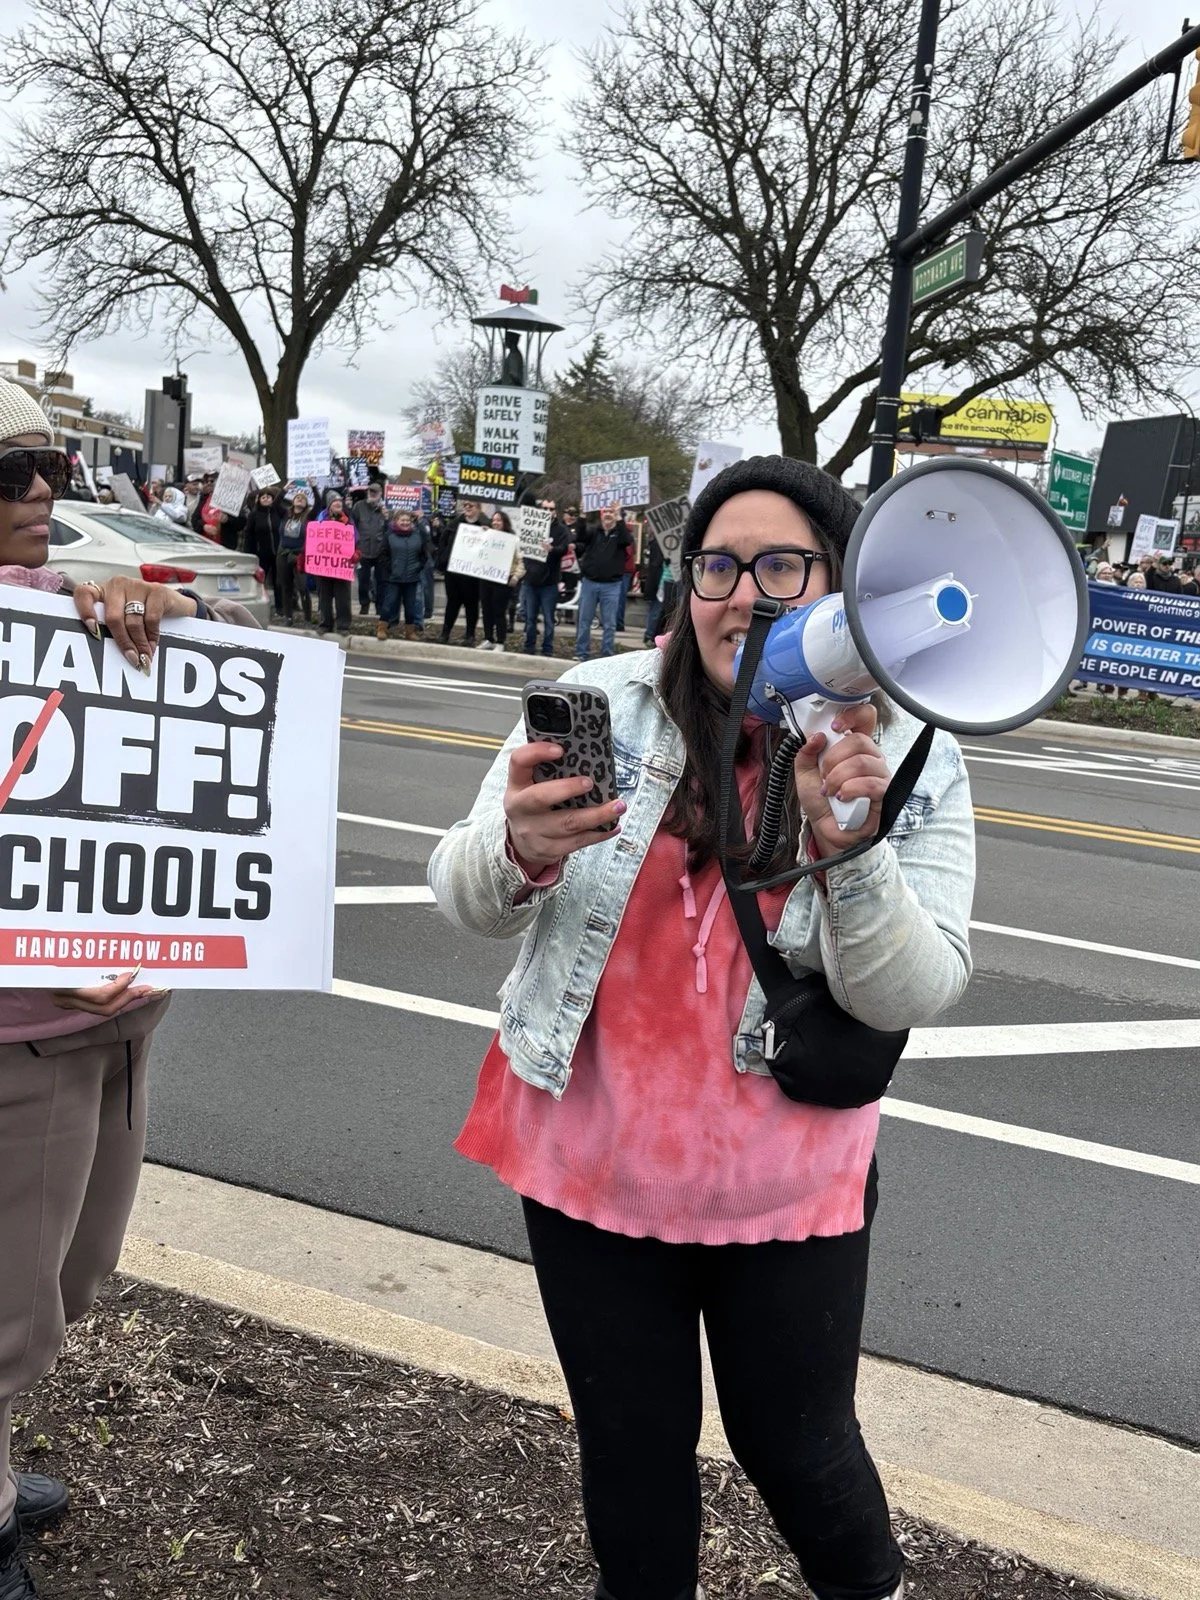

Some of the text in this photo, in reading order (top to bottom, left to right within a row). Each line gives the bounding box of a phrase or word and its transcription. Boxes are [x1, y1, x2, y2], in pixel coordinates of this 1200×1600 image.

[914, 251, 963, 292] WOODWARD AVE
[484, 395, 521, 408] DRIVE
[484, 409, 522, 422] SAFELY
[966, 407, 1047, 424] cannabis
[484, 428, 520, 440] WALK
[482, 442, 520, 454] RIGHT
[462, 454, 514, 471] THIS IS A
[583, 459, 646, 478] DEMOCRACY
[461, 468, 516, 486] HOSTILE
[618, 472, 640, 482] TIED
[458, 484, 516, 502] TAKEOVER!
[584, 487, 640, 510] TOGETHER
[523, 508, 550, 521] HANDS
[646, 496, 690, 534] HANDS
[308, 528, 353, 542] DEFEND
[316, 542, 342, 554] OUR
[306, 554, 354, 568] FUTURE
[1148, 604, 1192, 617] FIGHTING
[1092, 617, 1147, 636] POWER
[1150, 626, 1172, 640] OF
[1092, 638, 1108, 650] IS
[1111, 642, 1181, 662] GREATER
[0, 621, 266, 716] HANDS
[1099, 660, 1158, 680] PEOPLE
[1160, 670, 1180, 684] IN
[0, 692, 264, 820] OFF!
[0, 834, 272, 920] CHOOLS
[15, 936, 205, 962] HANDSOFFNOW.ORG
